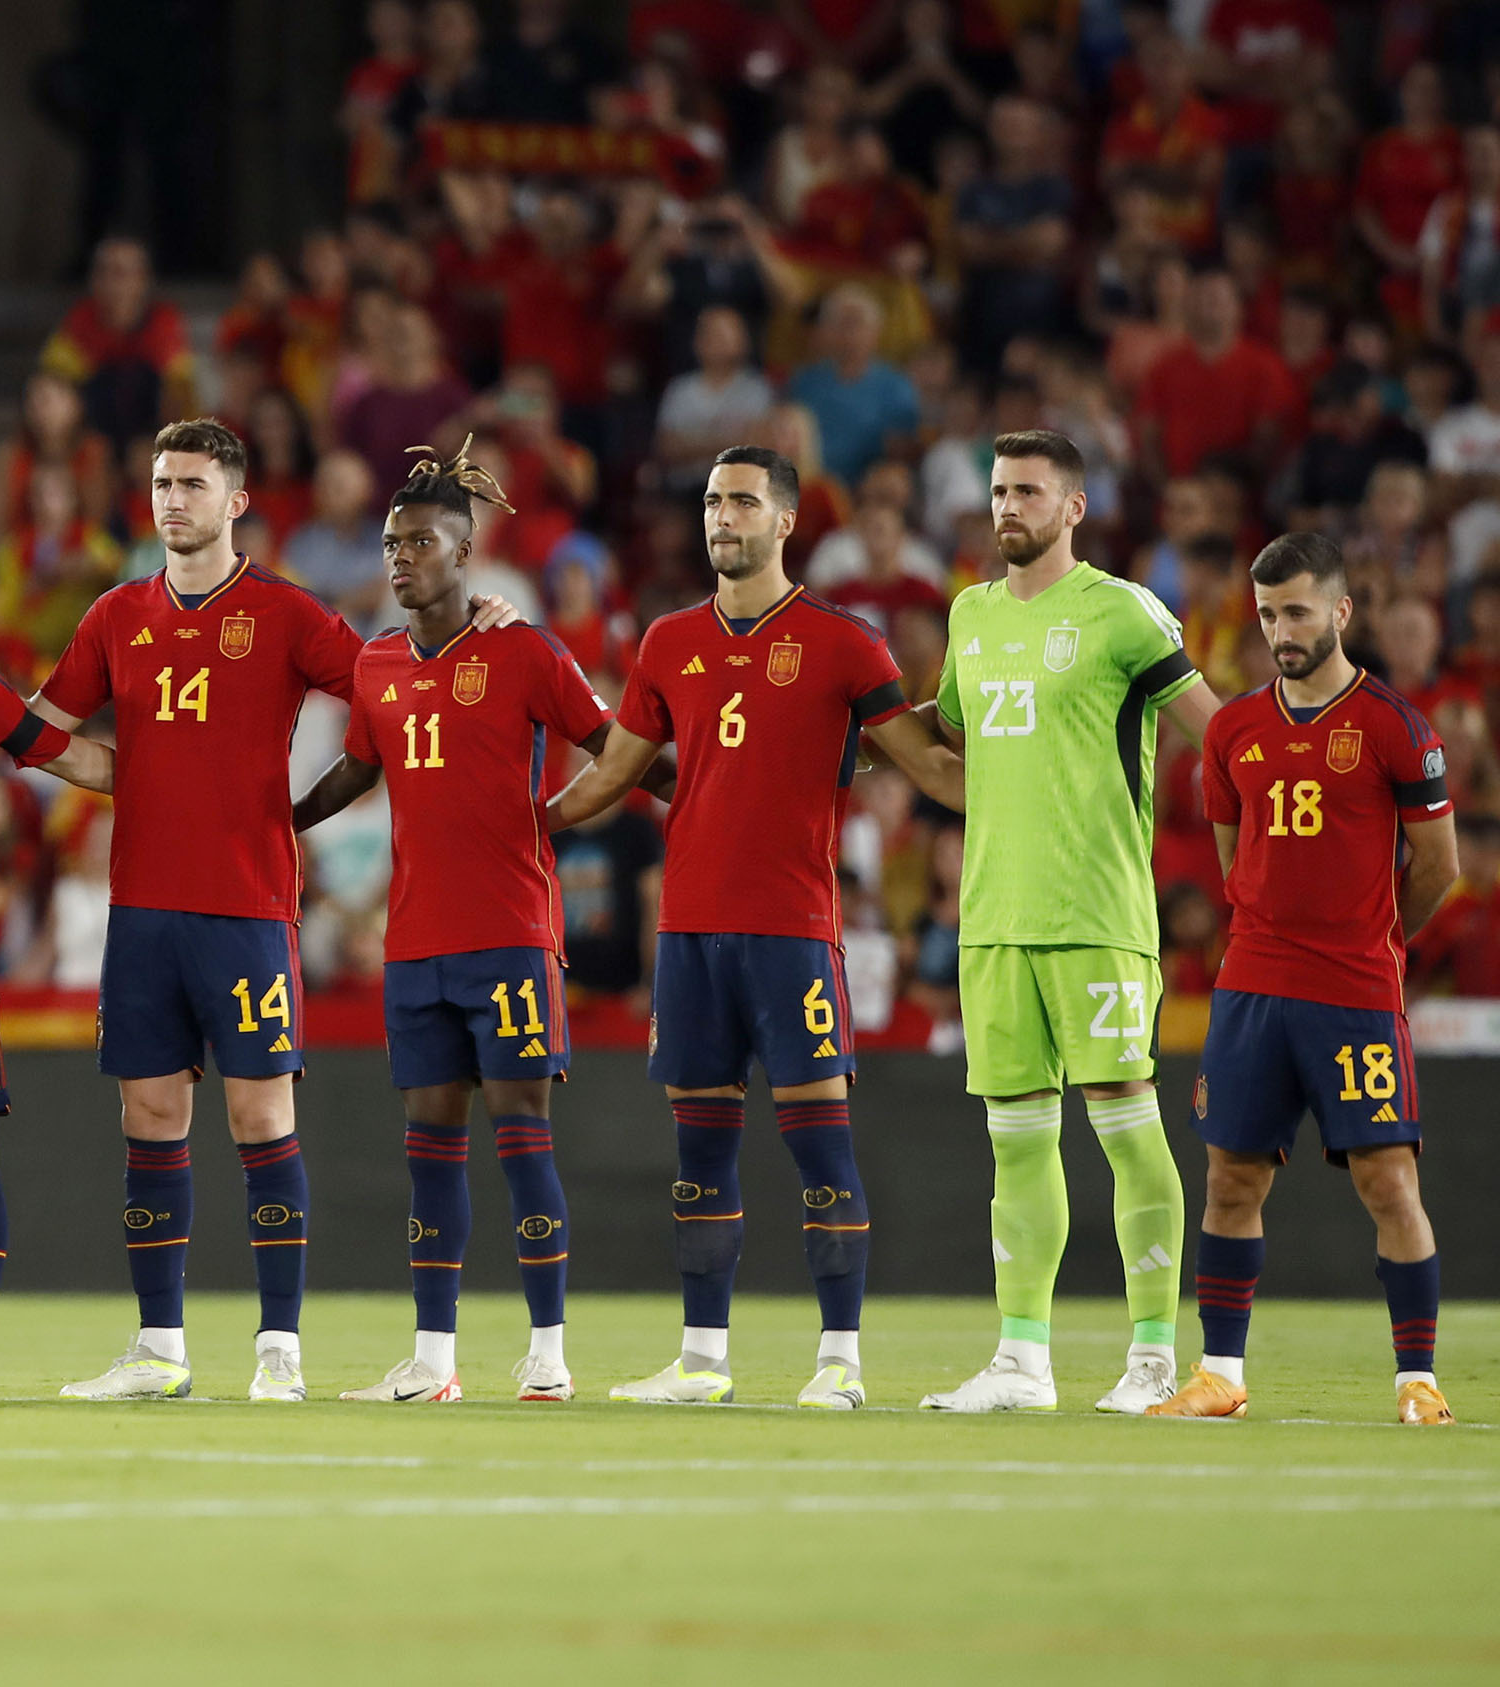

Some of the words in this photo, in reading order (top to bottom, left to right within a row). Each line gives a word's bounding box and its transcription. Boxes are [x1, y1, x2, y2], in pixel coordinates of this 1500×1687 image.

[155, 667, 210, 722] 14
[718, 692, 746, 748] 6
[979, 679, 1038, 738] 23
[402, 710, 446, 771] 11
[1267, 780, 1324, 837] 18
[230, 970, 291, 1034] 14
[490, 977, 546, 1038] 11
[802, 978, 836, 1036] 6
[1085, 979, 1150, 1039] 23
[1332, 1042, 1399, 1102] 18
